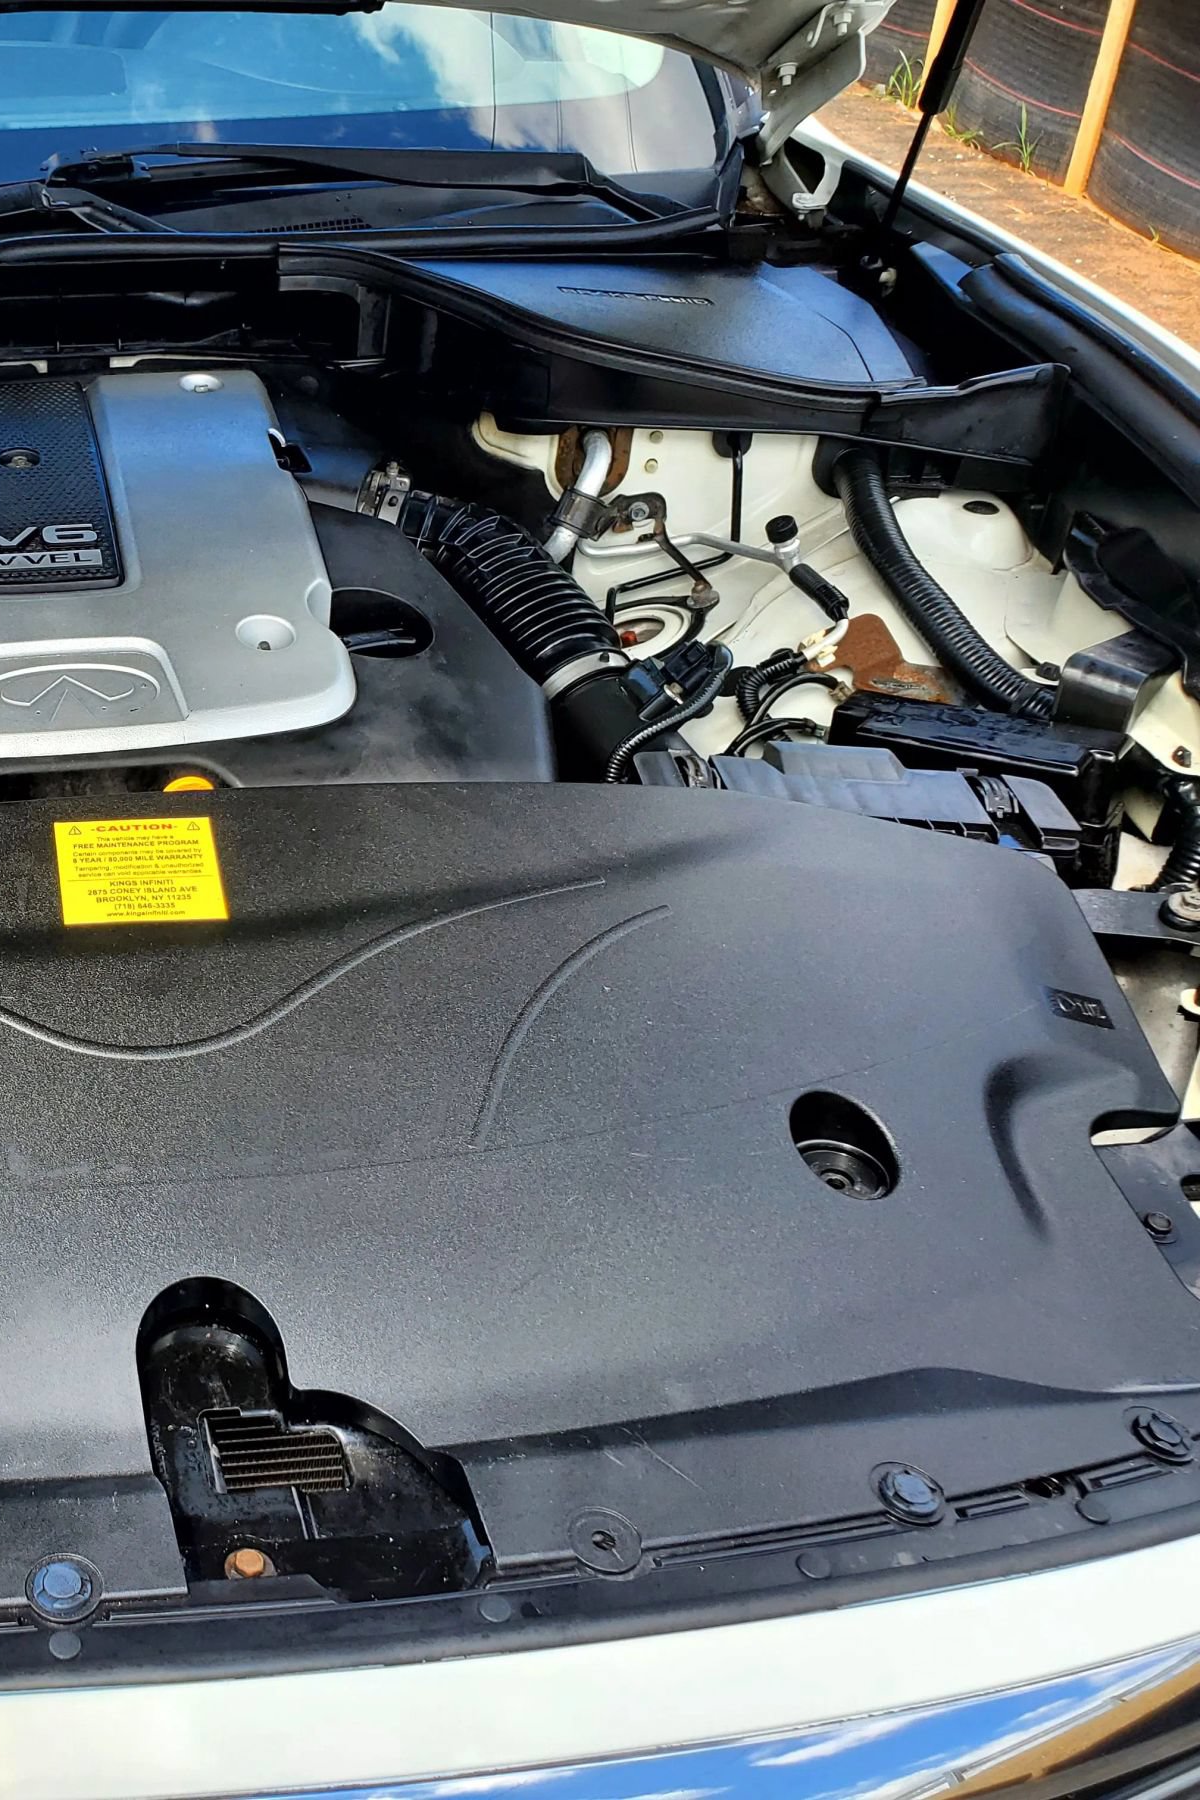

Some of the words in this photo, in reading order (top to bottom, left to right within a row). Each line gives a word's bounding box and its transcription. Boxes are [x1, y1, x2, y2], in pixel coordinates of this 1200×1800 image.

[110, 887, 141, 895] CONEY
[96, 895, 150, 903] BROOKLYN,
[114, 903, 135, 911] (718)
